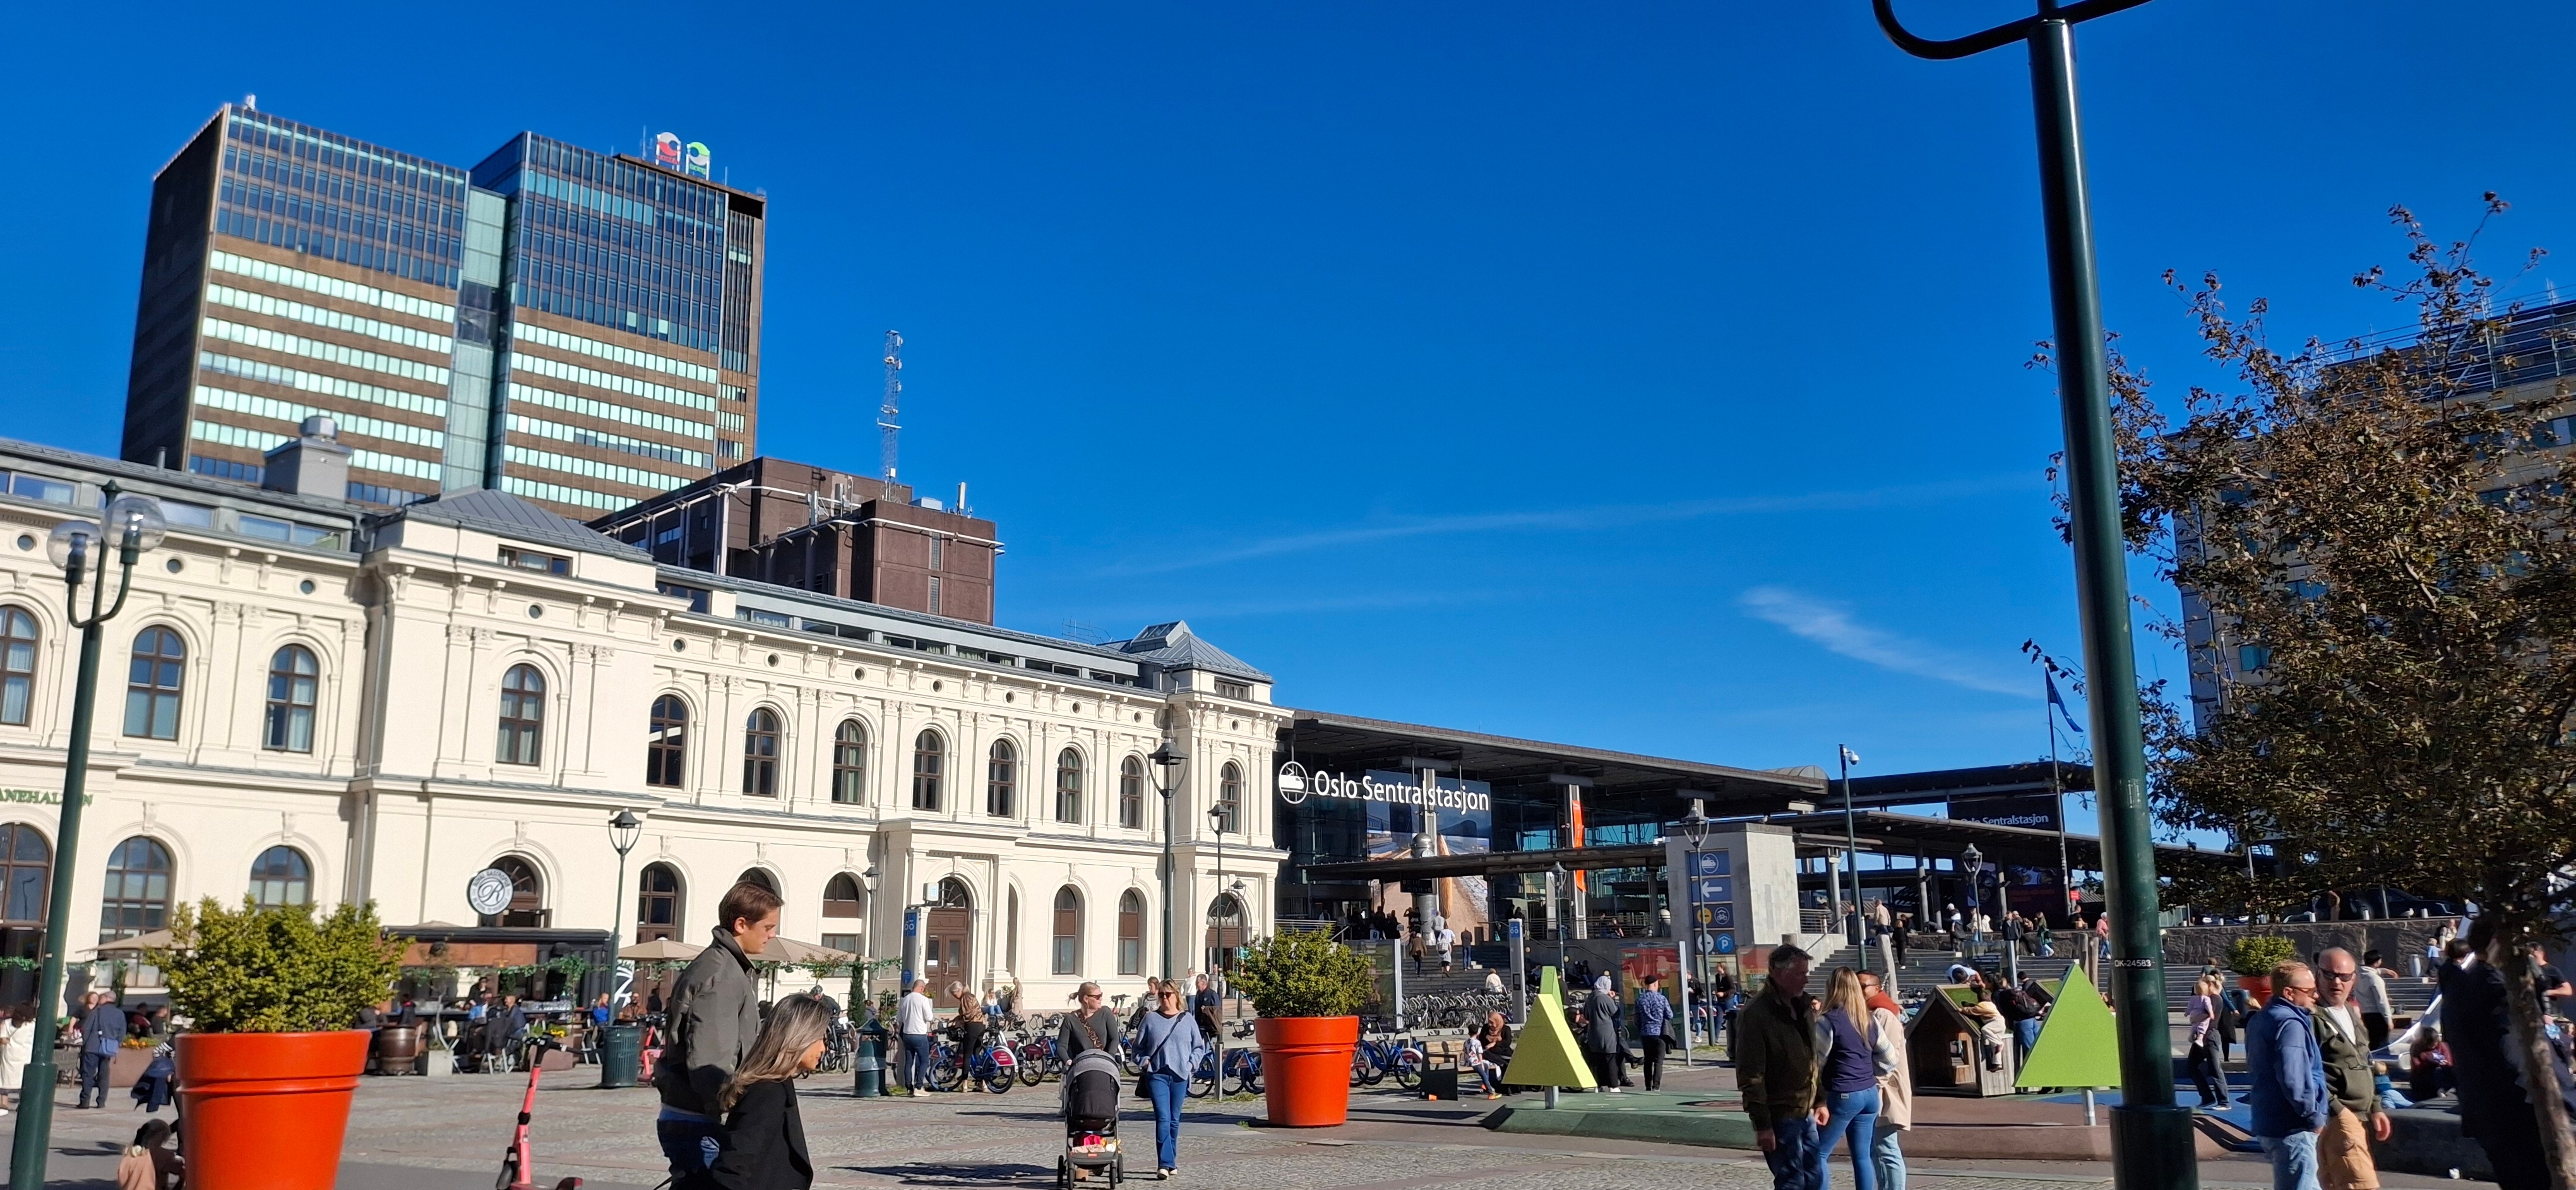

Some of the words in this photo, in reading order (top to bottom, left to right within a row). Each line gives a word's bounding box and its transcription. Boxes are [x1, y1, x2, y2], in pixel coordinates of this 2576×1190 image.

[0, 788, 93, 806] NEHALN
[1315, 771, 1357, 798] Oslo
[1363, 775, 1489, 815] Sentralstasjon
[1983, 814, 2049, 826] Sentralstasjon
[1722, 940, 1728, 949] P
